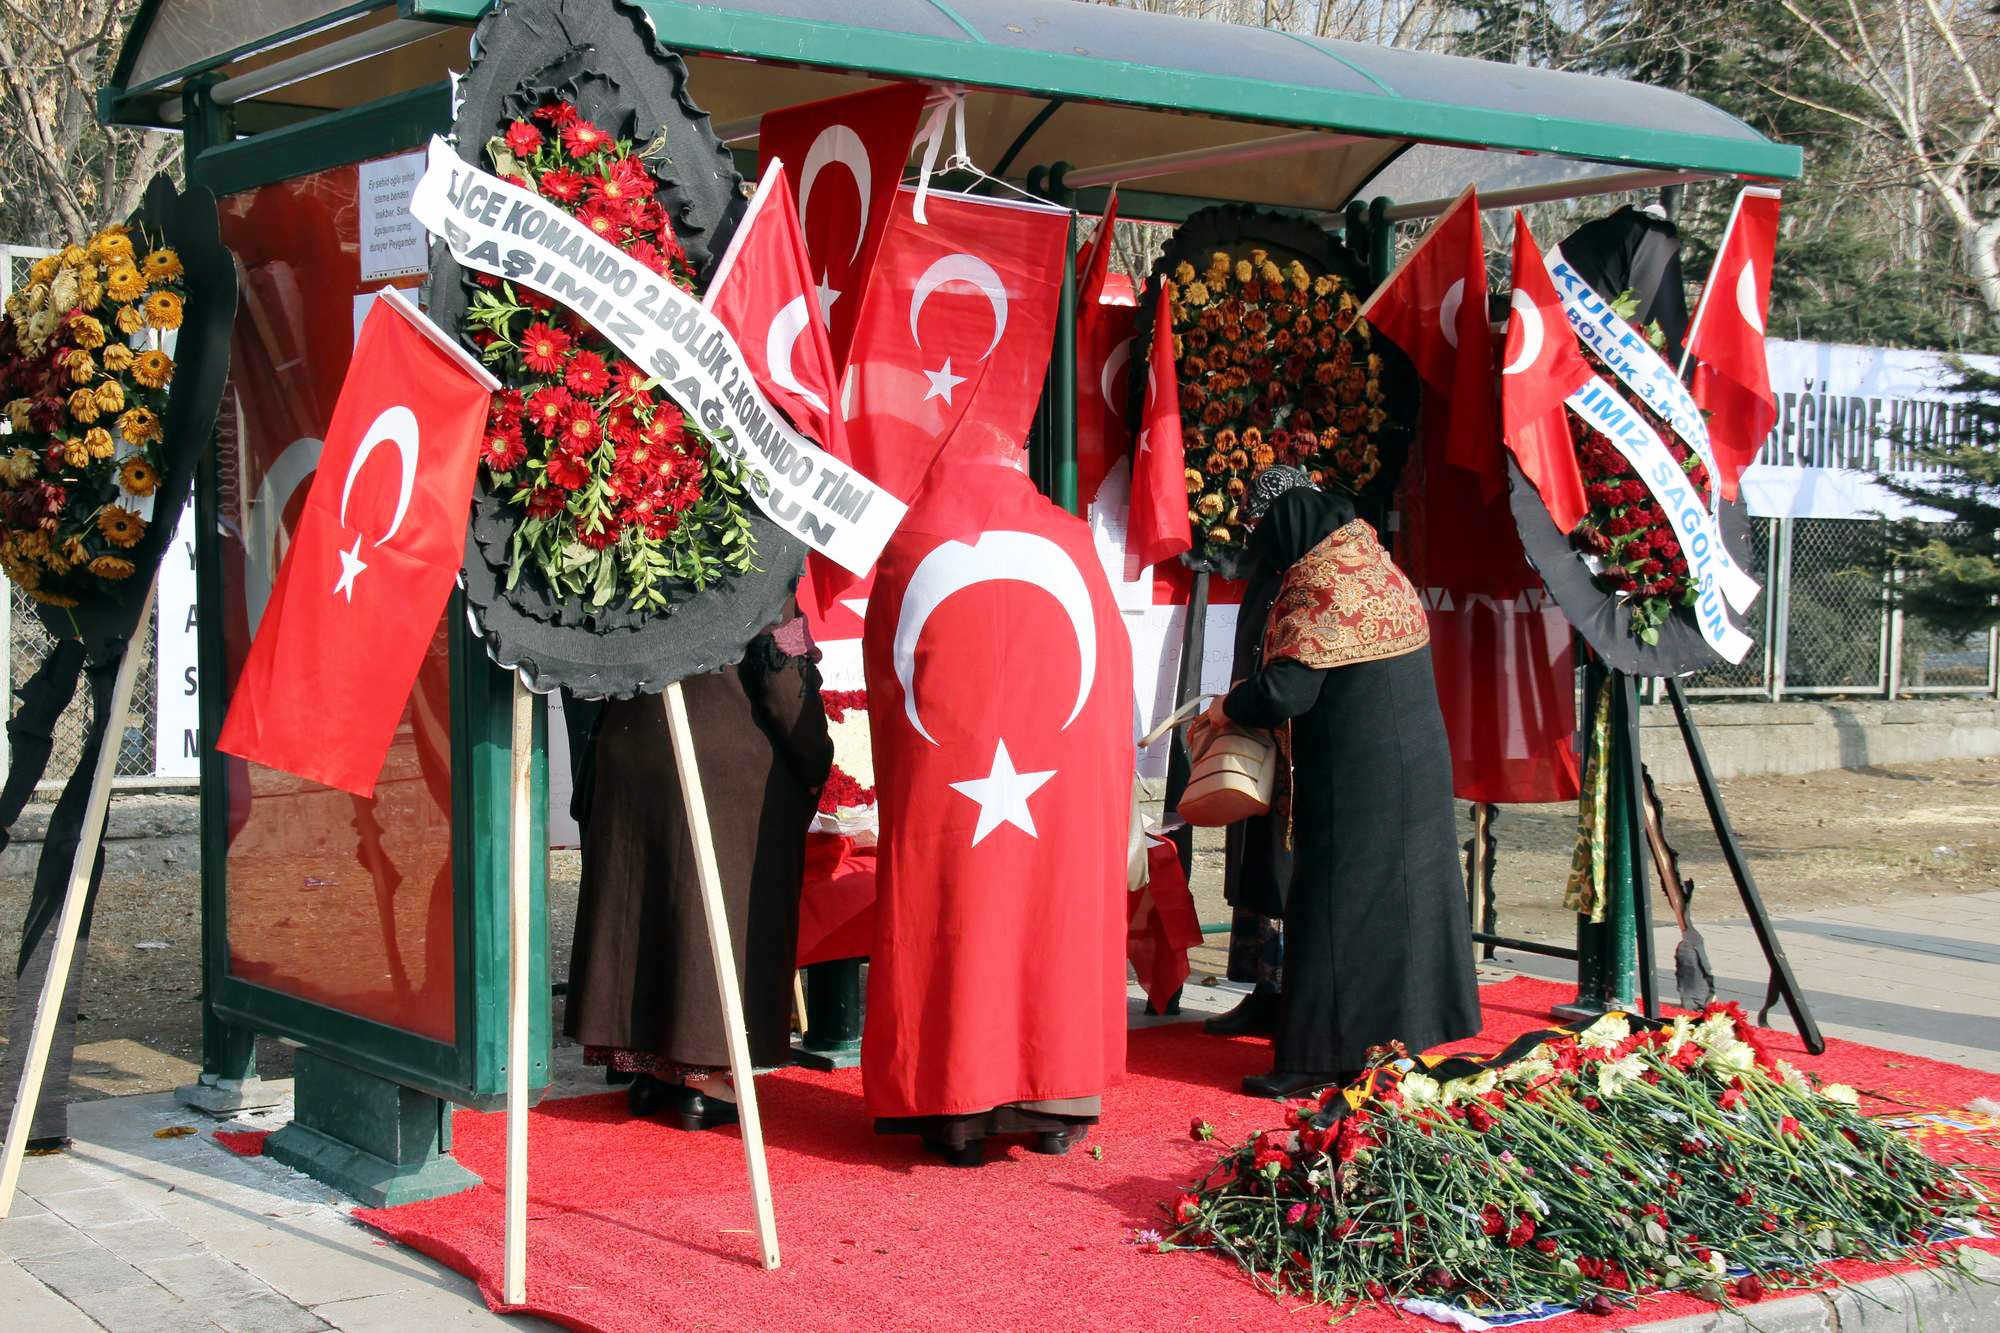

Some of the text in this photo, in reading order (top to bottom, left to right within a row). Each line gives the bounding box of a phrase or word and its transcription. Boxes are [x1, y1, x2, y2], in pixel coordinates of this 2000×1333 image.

[501, 200, 638, 298] KOMANDO
[1552, 263, 1646, 354] KULP
[1557, 291, 1639, 382] BÖLÜK
[444, 216, 836, 547] BAŞIMIZ SAĞOSUN
[1761, 378, 1882, 470] REĞİNDE
